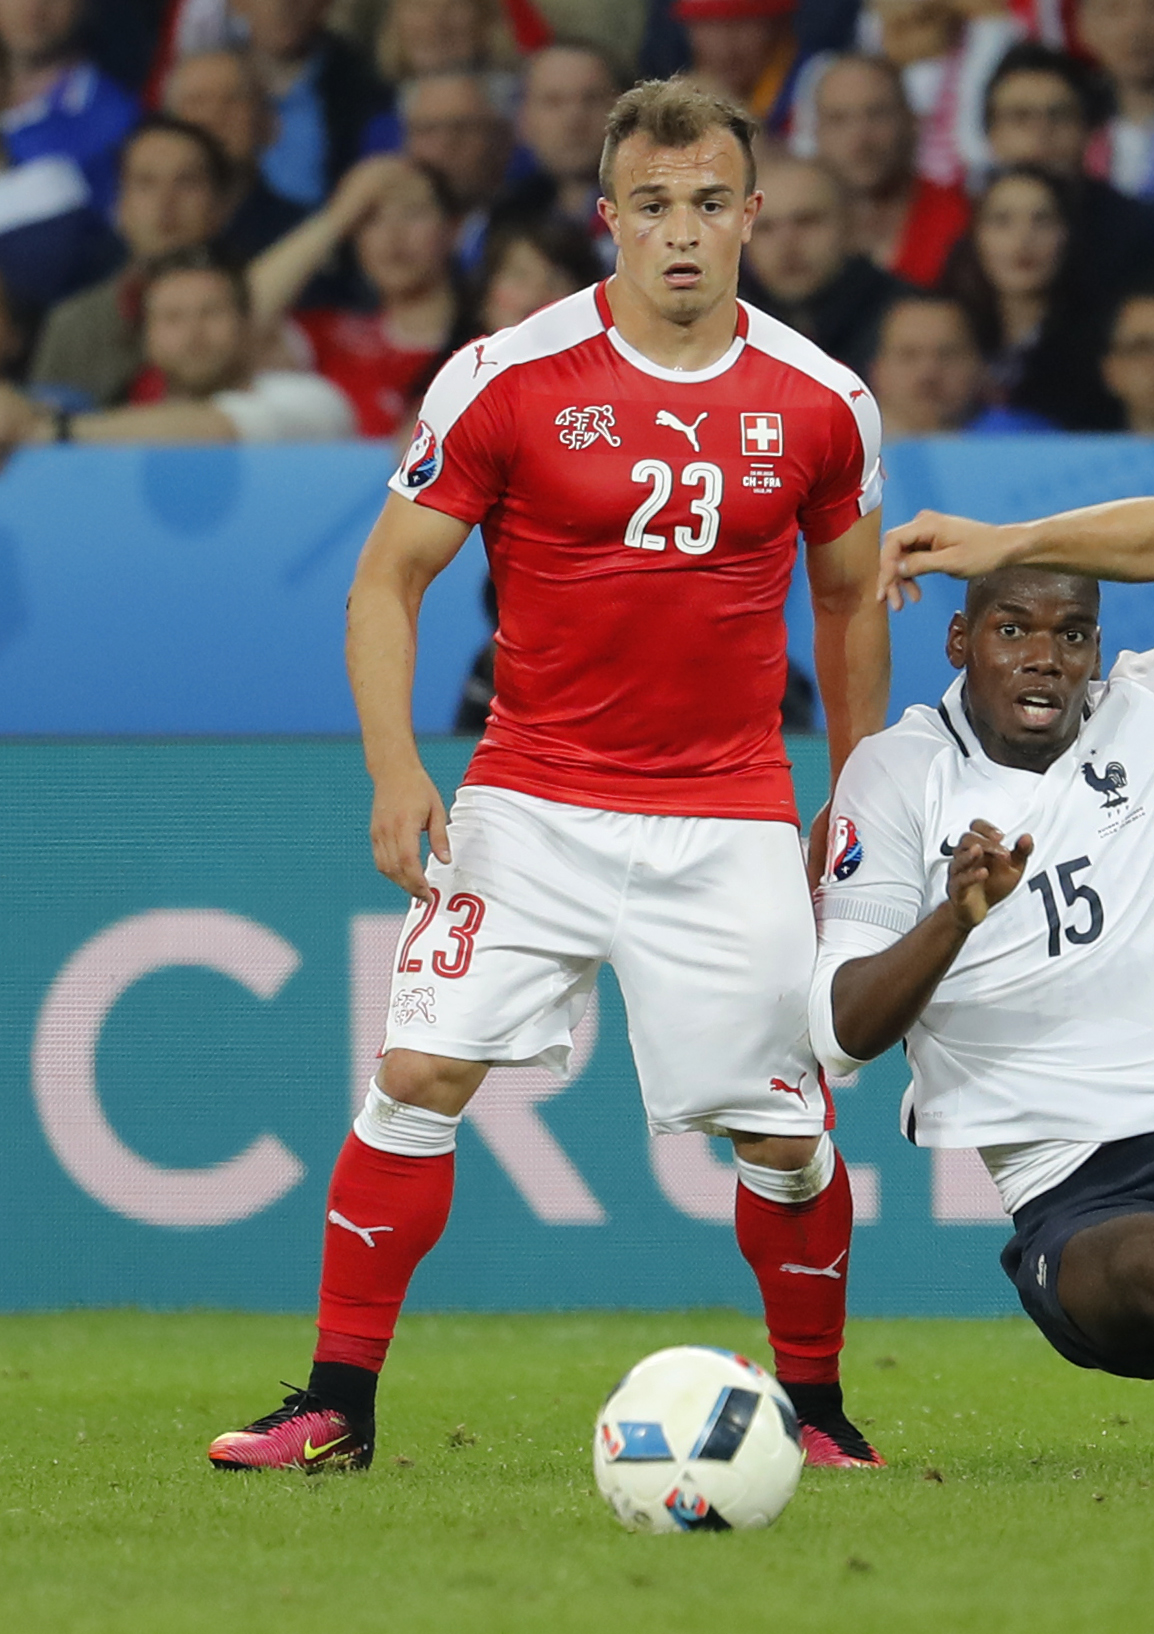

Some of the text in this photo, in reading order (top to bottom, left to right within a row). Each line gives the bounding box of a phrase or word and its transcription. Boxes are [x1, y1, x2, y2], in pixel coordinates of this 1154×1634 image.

[624, 458, 724, 555] 23
[398, 886, 486, 979] 23
[1027, 854, 1105, 957] 15
